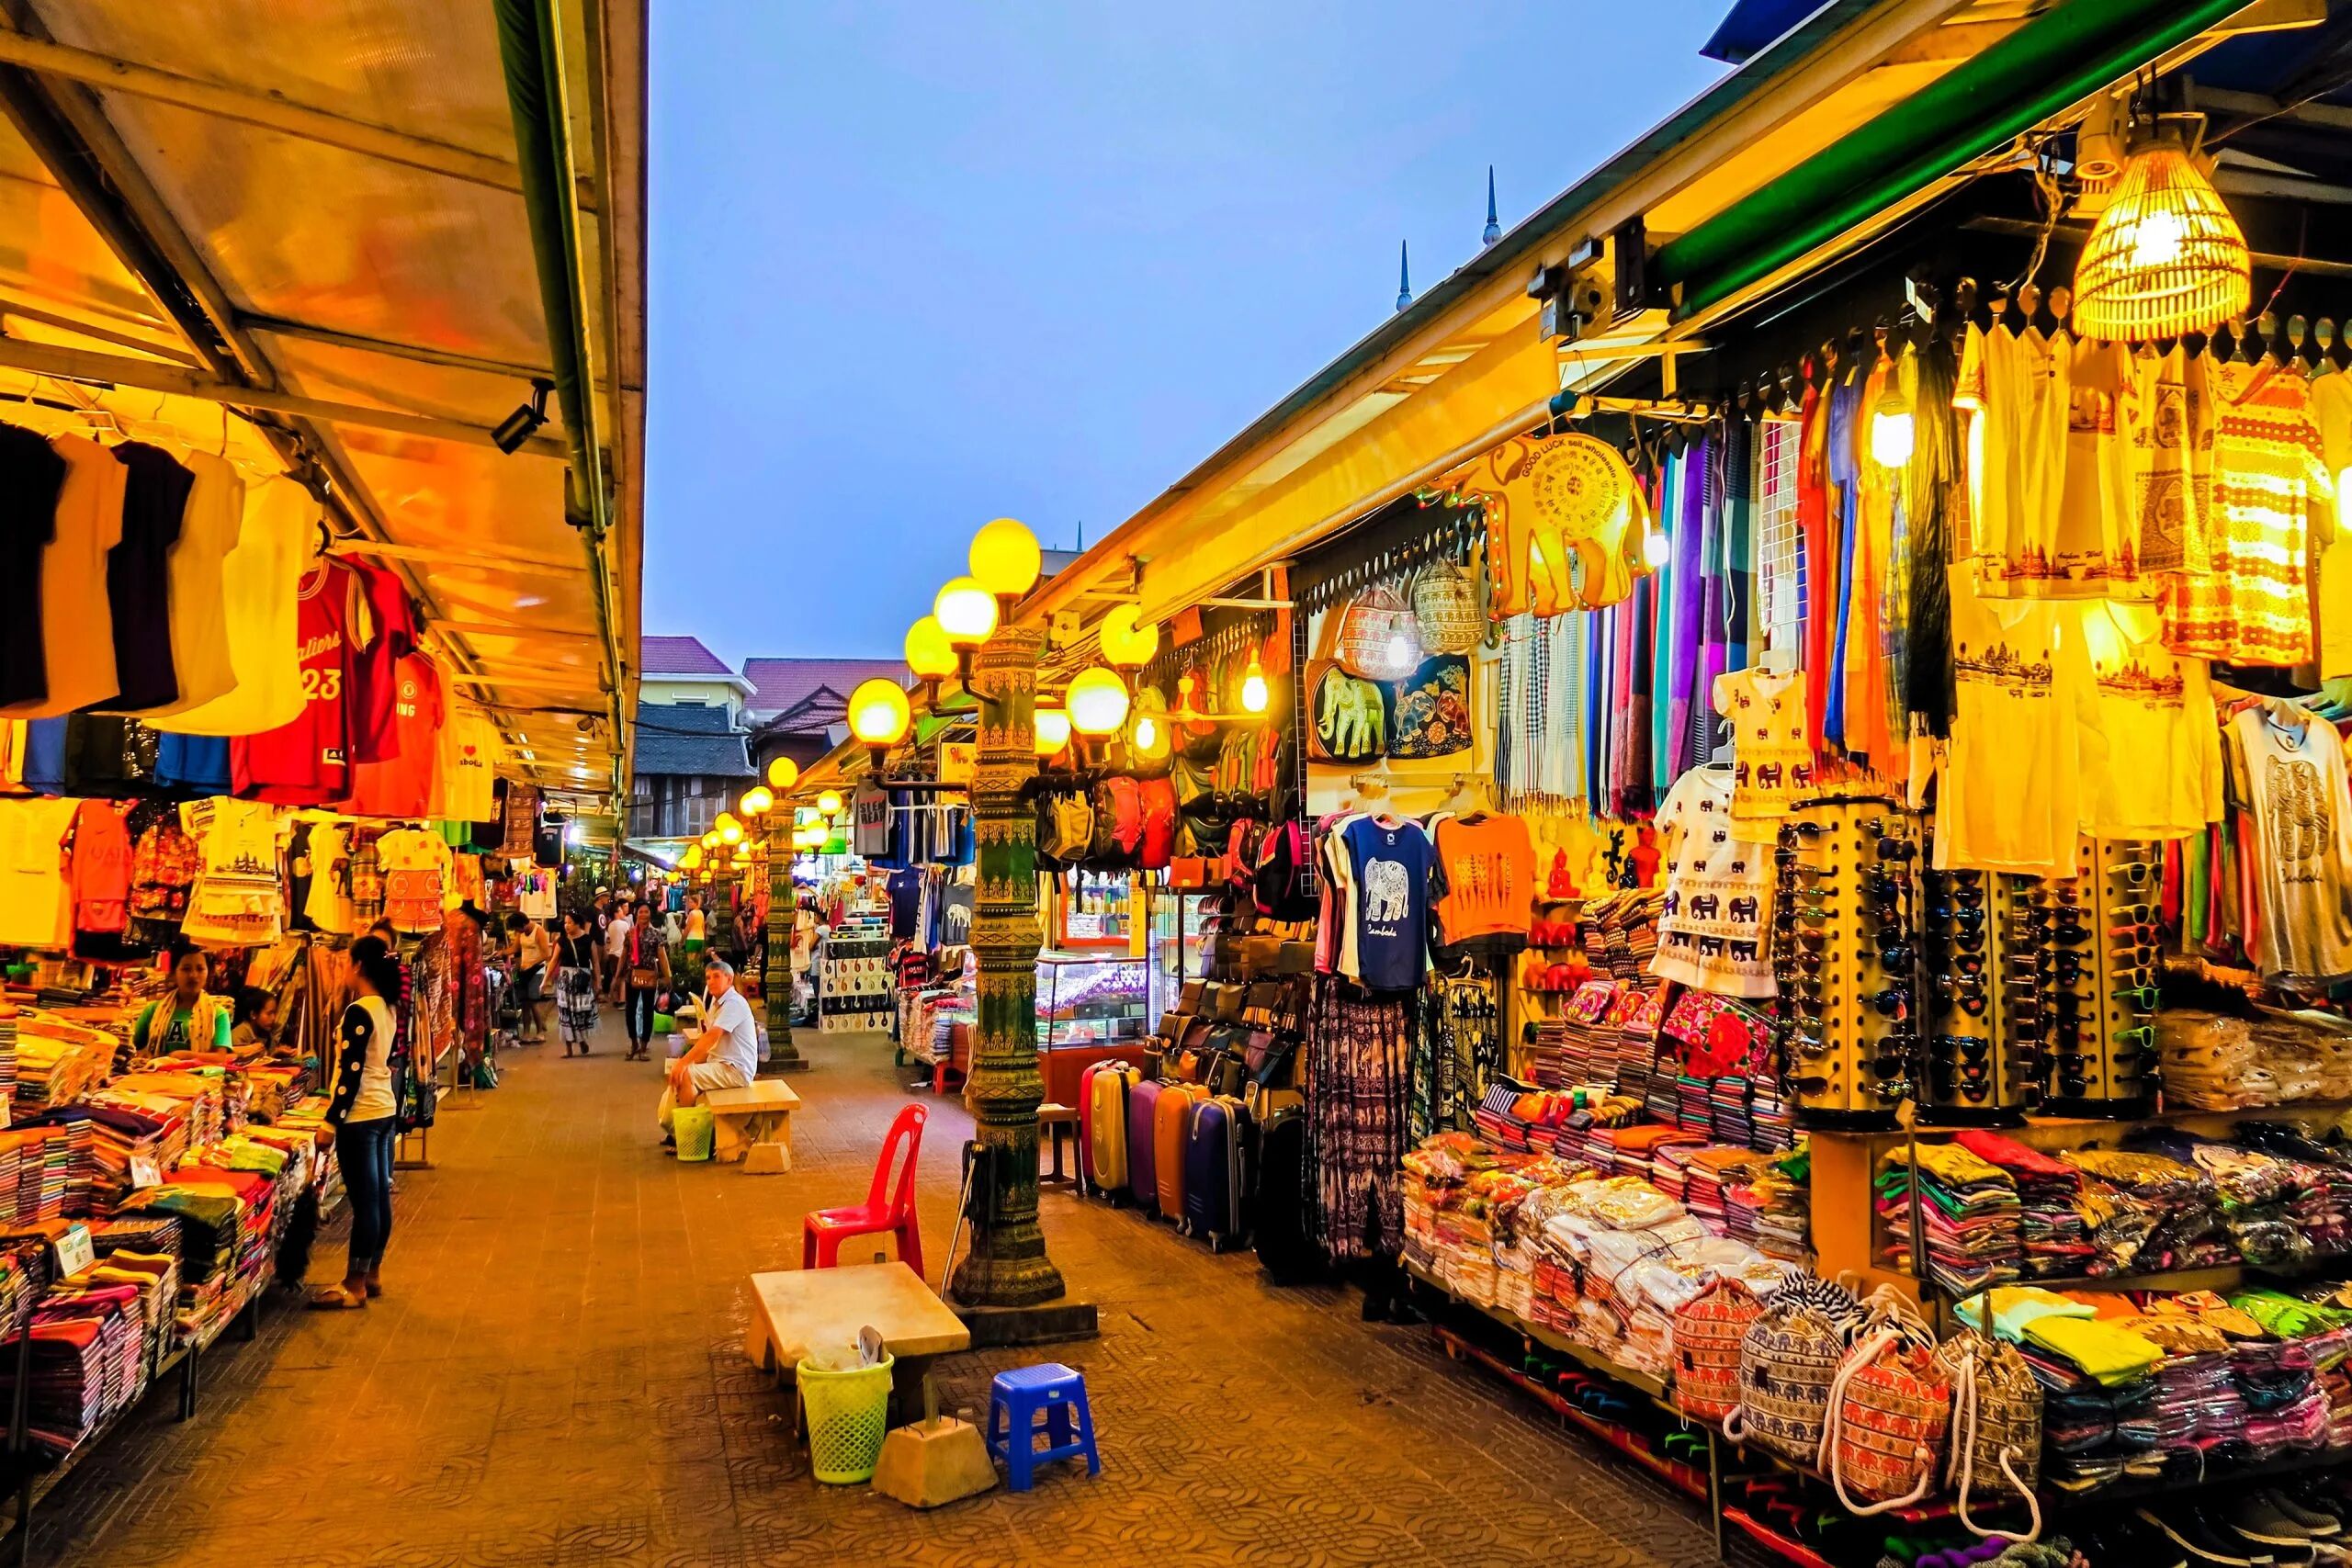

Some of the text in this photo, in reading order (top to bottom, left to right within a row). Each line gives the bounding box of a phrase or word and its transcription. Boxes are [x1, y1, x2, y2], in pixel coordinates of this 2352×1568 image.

[1521, 451, 1542, 478] GOOD
[1540, 439, 1566, 454] LUCK
[301, 668, 342, 701] 23
